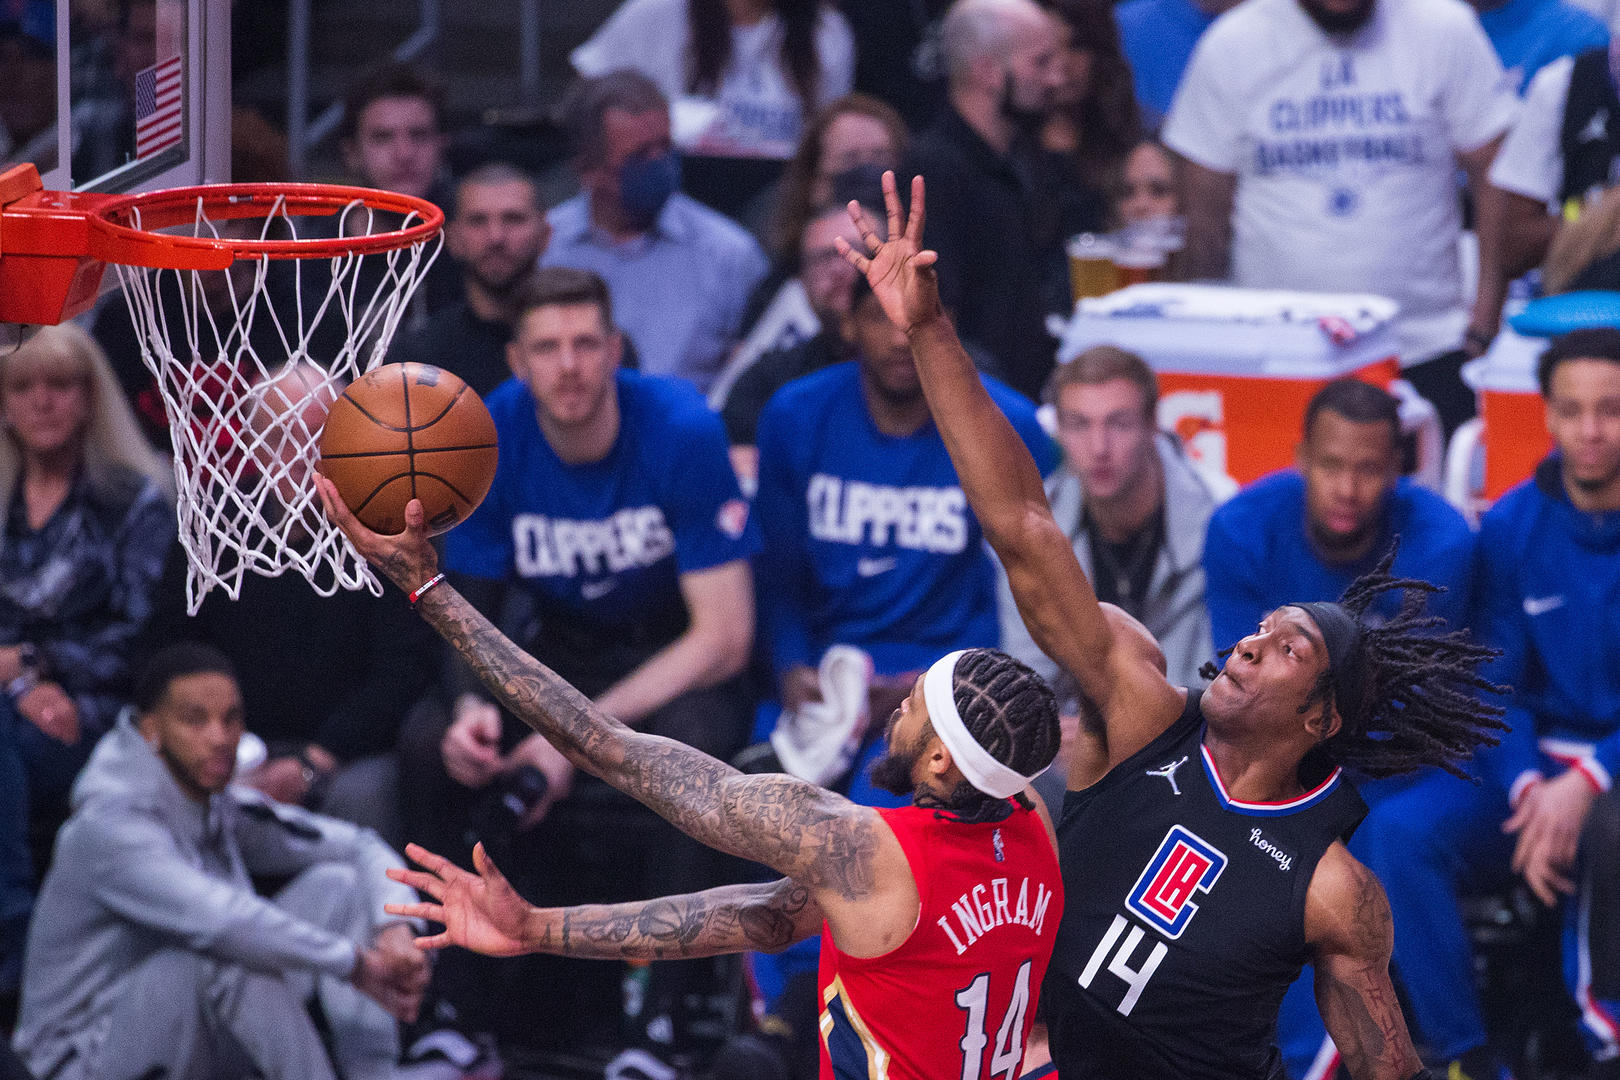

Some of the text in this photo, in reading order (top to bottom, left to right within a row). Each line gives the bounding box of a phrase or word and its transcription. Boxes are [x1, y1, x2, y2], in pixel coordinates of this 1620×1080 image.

[512, 505, 676, 578] CLIPPERS
[807, 473, 967, 554] CLIPPERS
[937, 877, 1052, 955] INGRAM
[1078, 913, 1168, 1017] 14
[955, 958, 1032, 1080] 14
